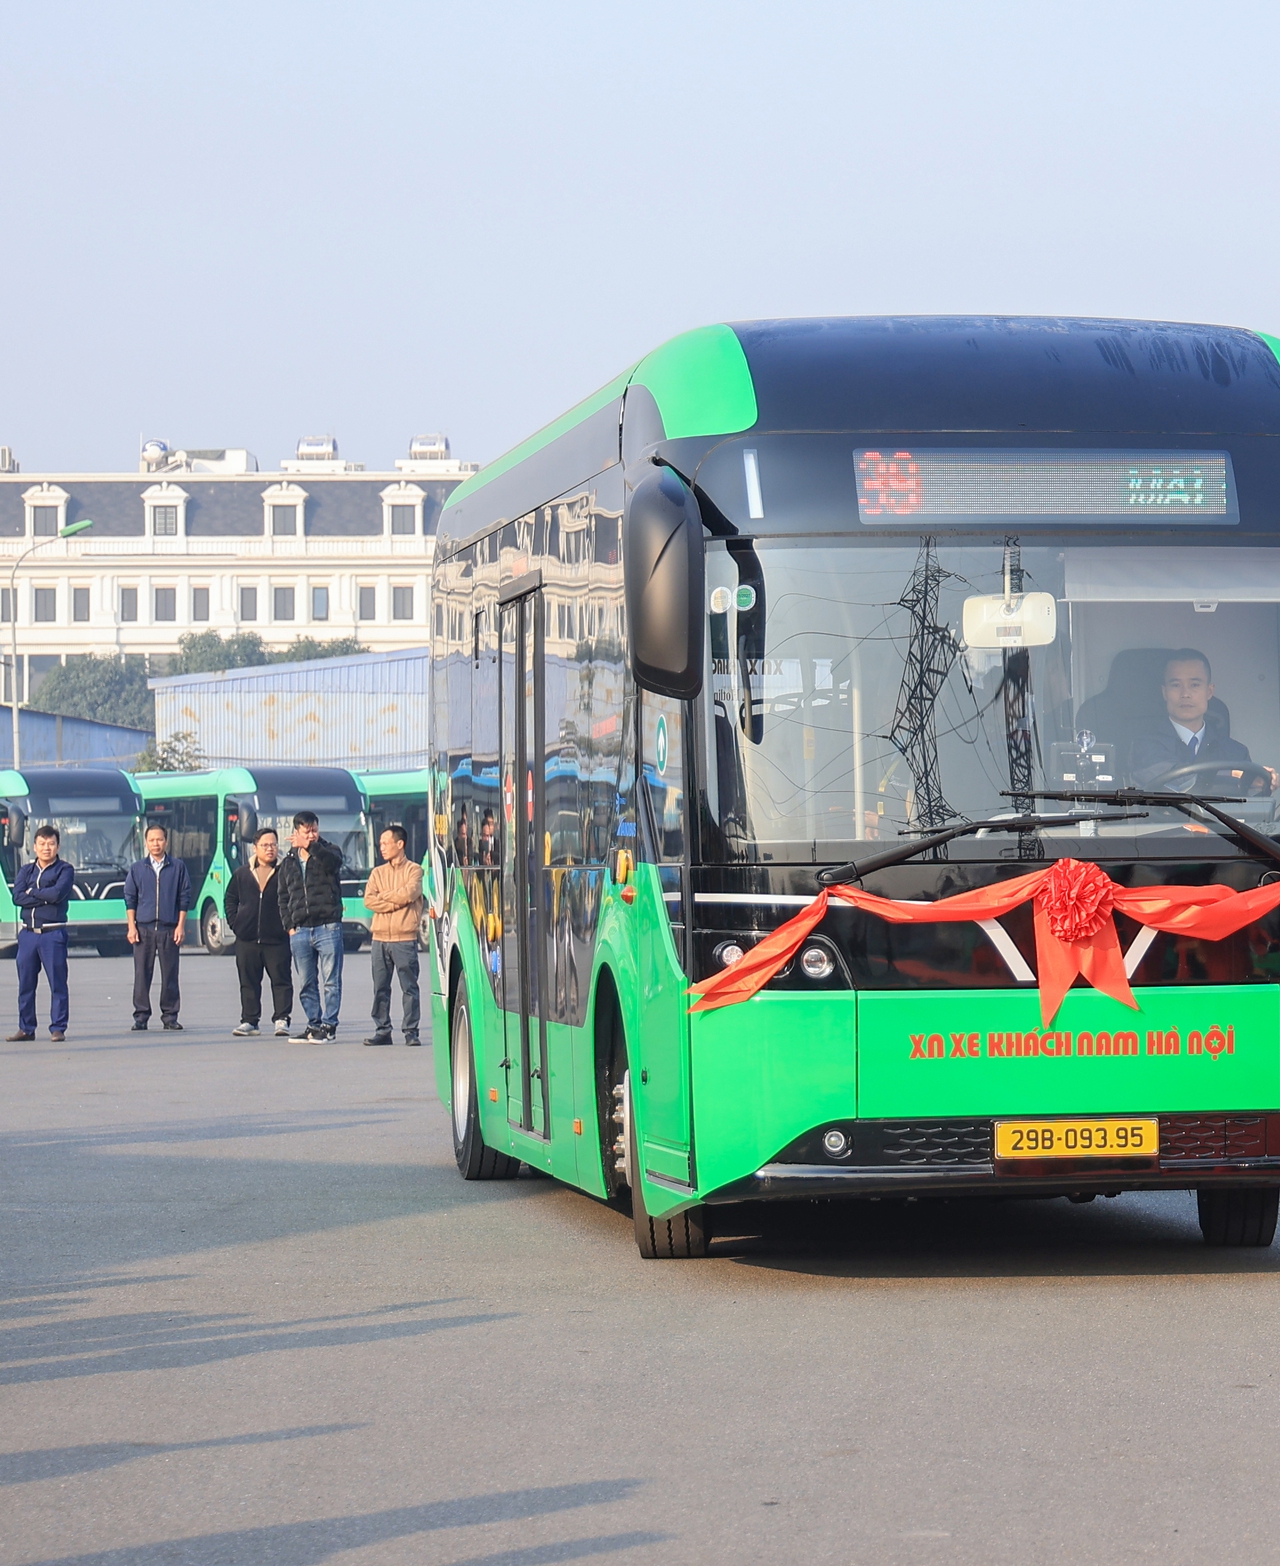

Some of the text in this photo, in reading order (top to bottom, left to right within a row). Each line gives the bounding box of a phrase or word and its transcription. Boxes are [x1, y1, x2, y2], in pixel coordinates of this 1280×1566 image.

[909, 1023, 1236, 1062] XN XE KHÁCH NAM HÀ NỘI
[1010, 1126, 1145, 1151] 29B-093.95
